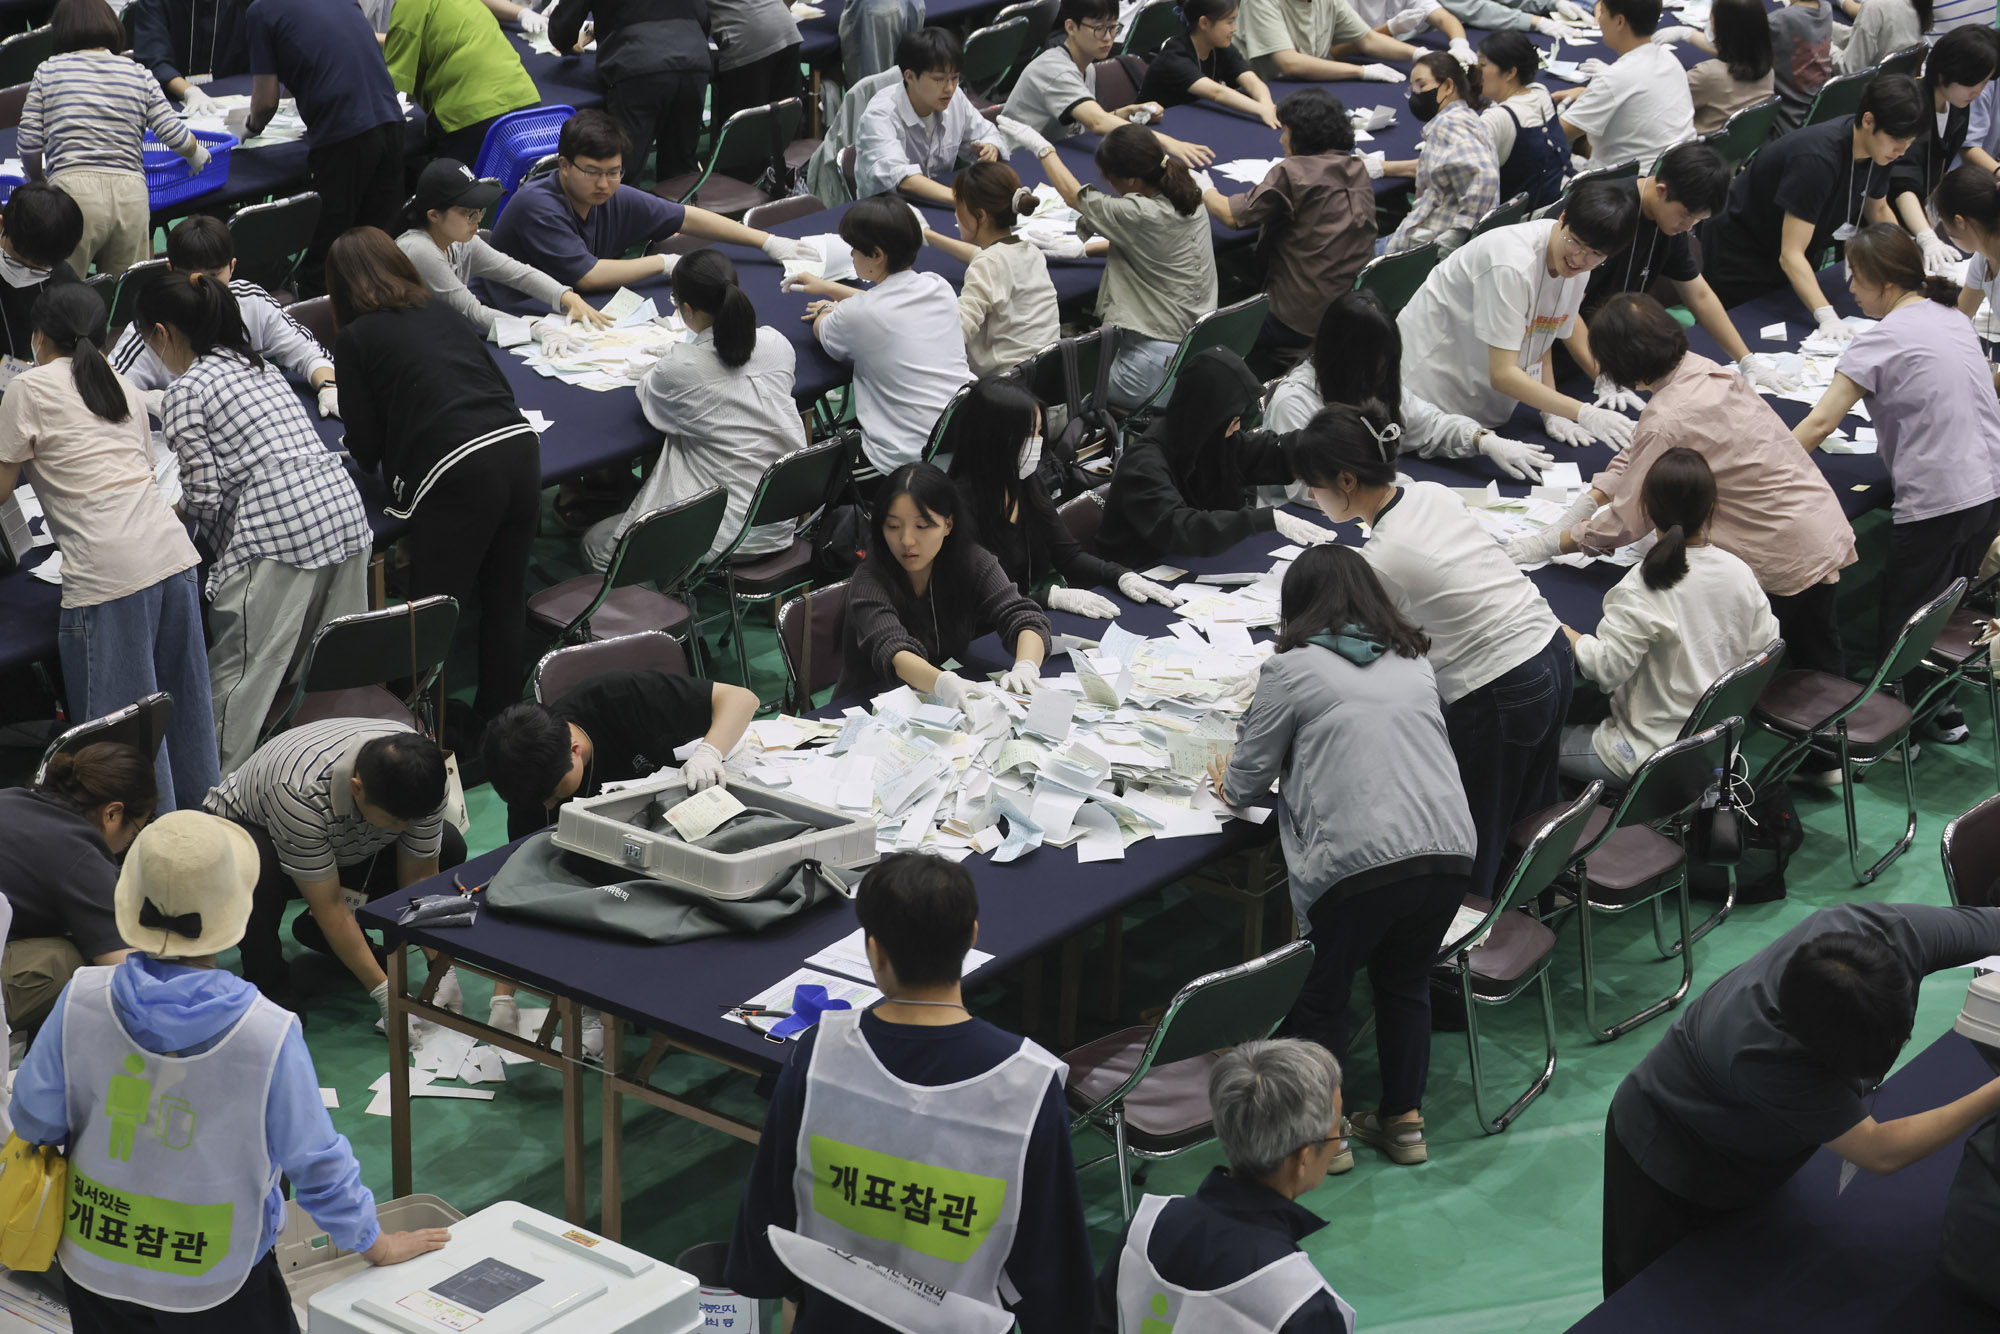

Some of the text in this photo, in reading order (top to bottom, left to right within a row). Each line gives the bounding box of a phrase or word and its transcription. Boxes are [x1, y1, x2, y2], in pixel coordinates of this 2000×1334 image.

[74, 1175, 131, 1216] 질서있는
[828, 1163, 978, 1237] 개표참관
[69, 1199, 207, 1264] 개표참관
[722, 1317, 734, 1327] 등
